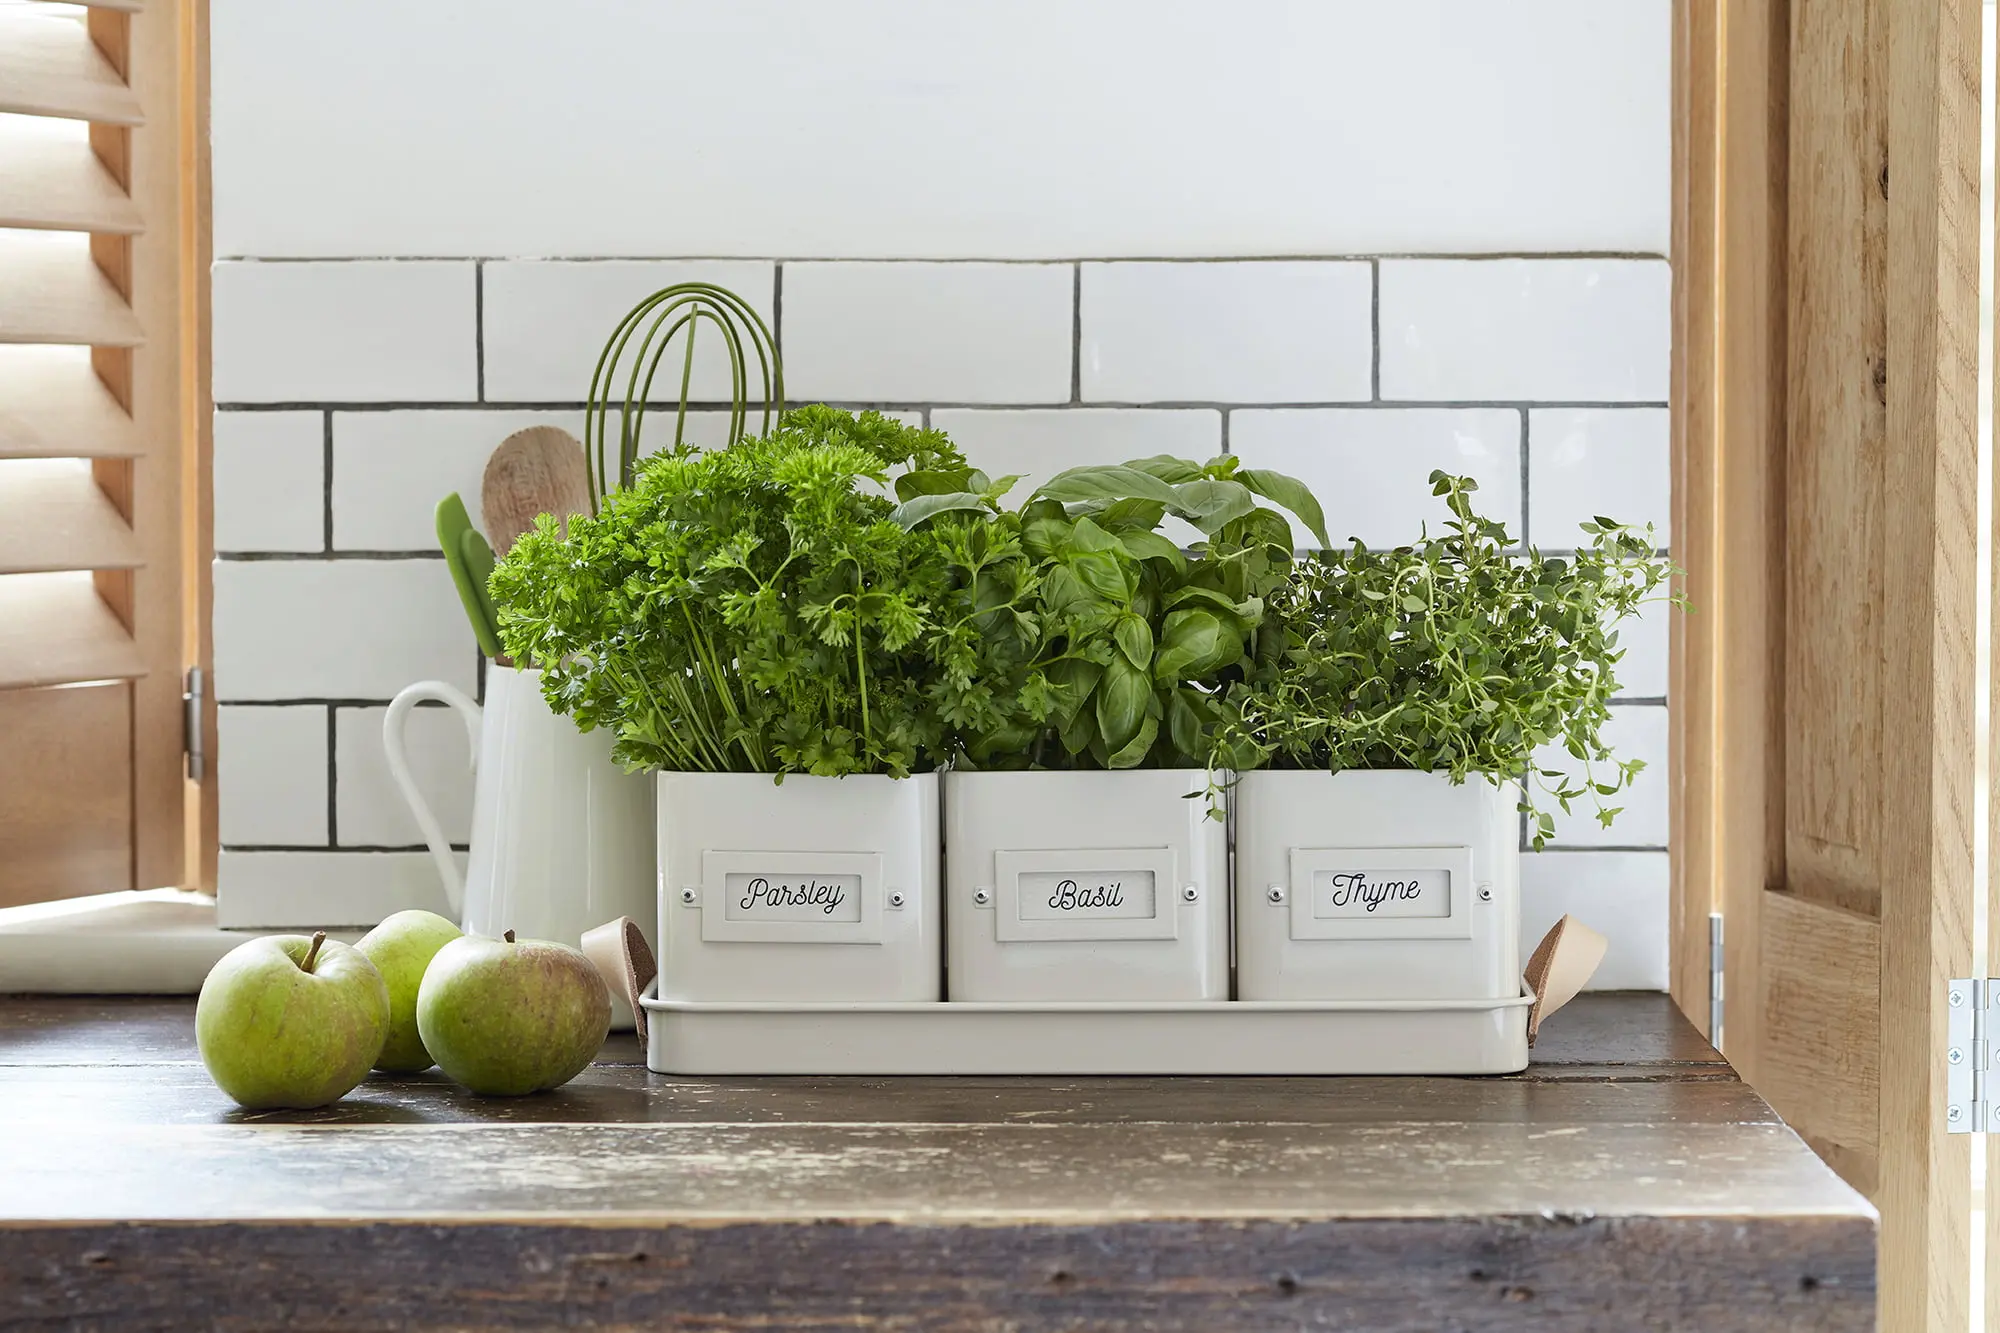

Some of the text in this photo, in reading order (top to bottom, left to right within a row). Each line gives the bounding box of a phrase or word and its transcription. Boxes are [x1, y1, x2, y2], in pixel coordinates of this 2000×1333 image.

[740, 878, 845, 914] Parsley
[1048, 879, 1124, 910] Basil
[1332, 873, 1421, 913] Thyme
